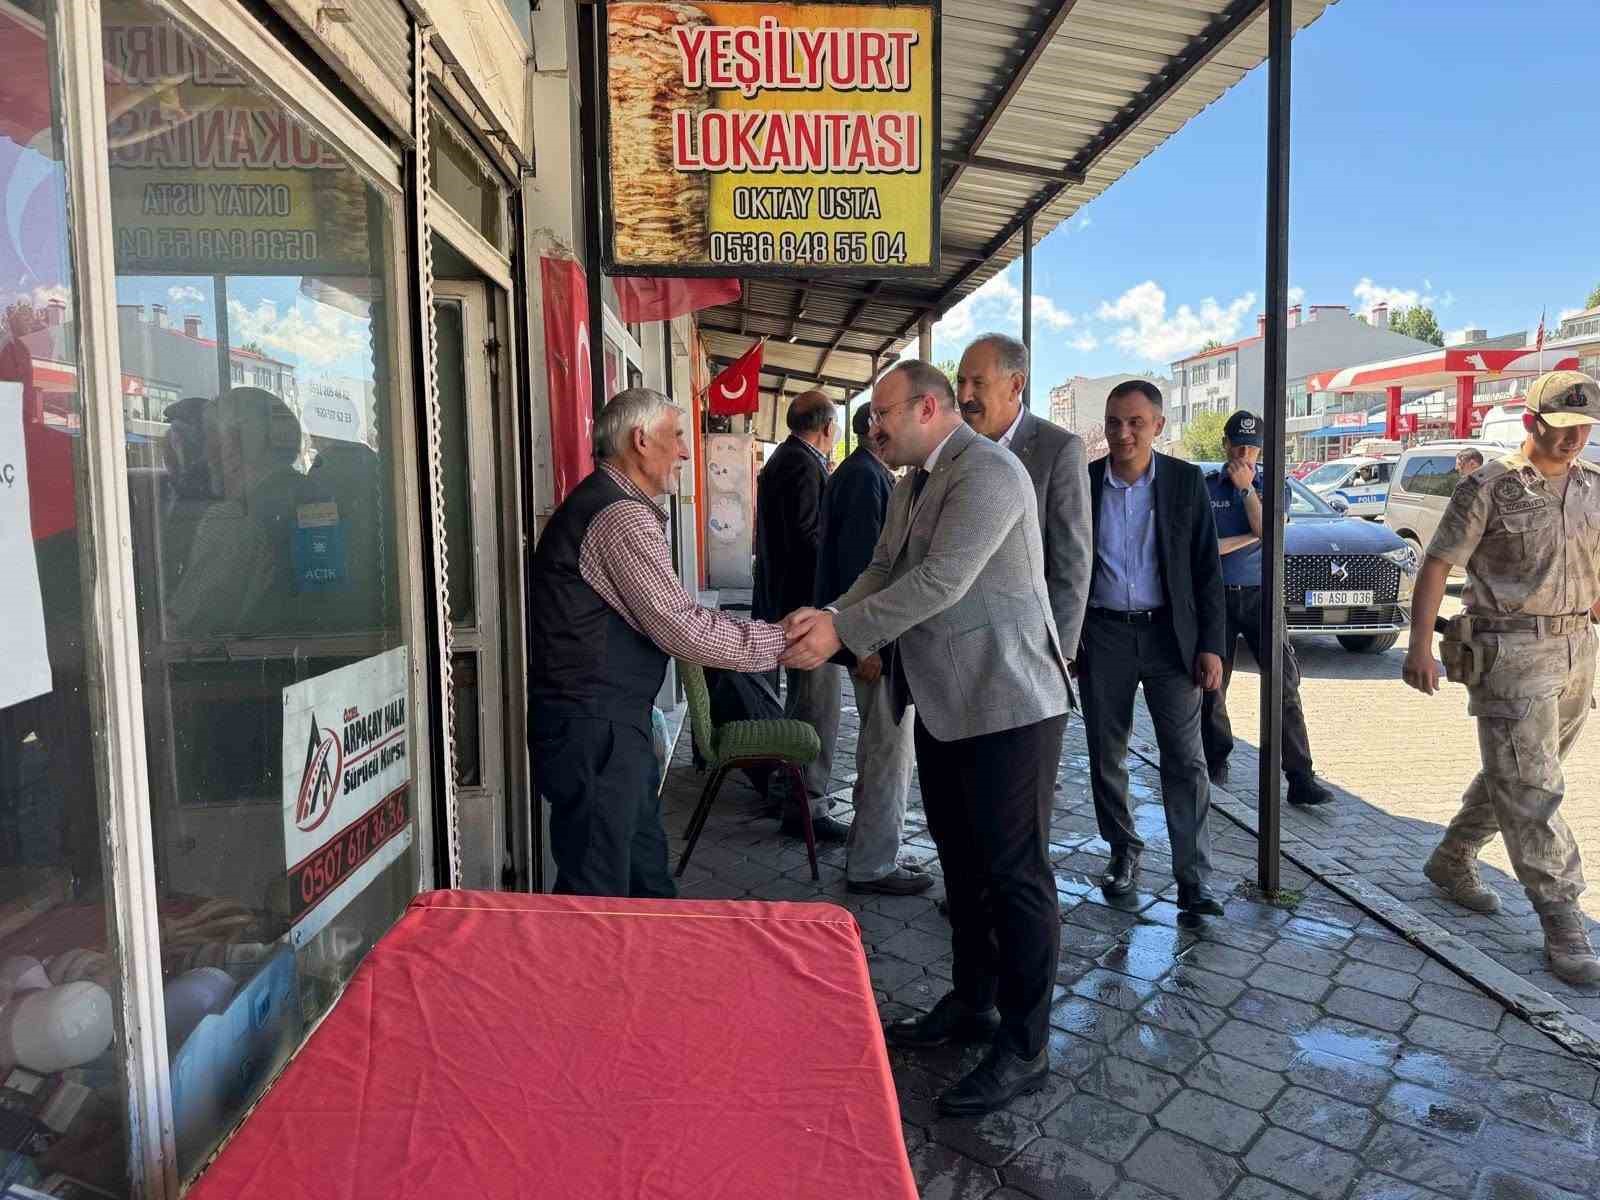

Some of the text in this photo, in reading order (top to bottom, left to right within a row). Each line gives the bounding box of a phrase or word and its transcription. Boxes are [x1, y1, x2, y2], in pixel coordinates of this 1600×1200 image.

[675, 18, 915, 95] YEŞİLYURT
[674, 110, 918, 171] LOKANTASI
[733, 187, 881, 219] OKTAY USTA
[709, 232, 907, 264] 0536 848 55 04
[1312, 592, 1323, 604] 16
[1352, 592, 1371, 604] 036
[343, 697, 405, 757] ARPAÇAY HALK
[343, 740, 406, 795] Sürücü Kursu
[302, 842, 343, 903] 0507
[347, 822, 369, 866] 617
[371, 808, 386, 845] 36
